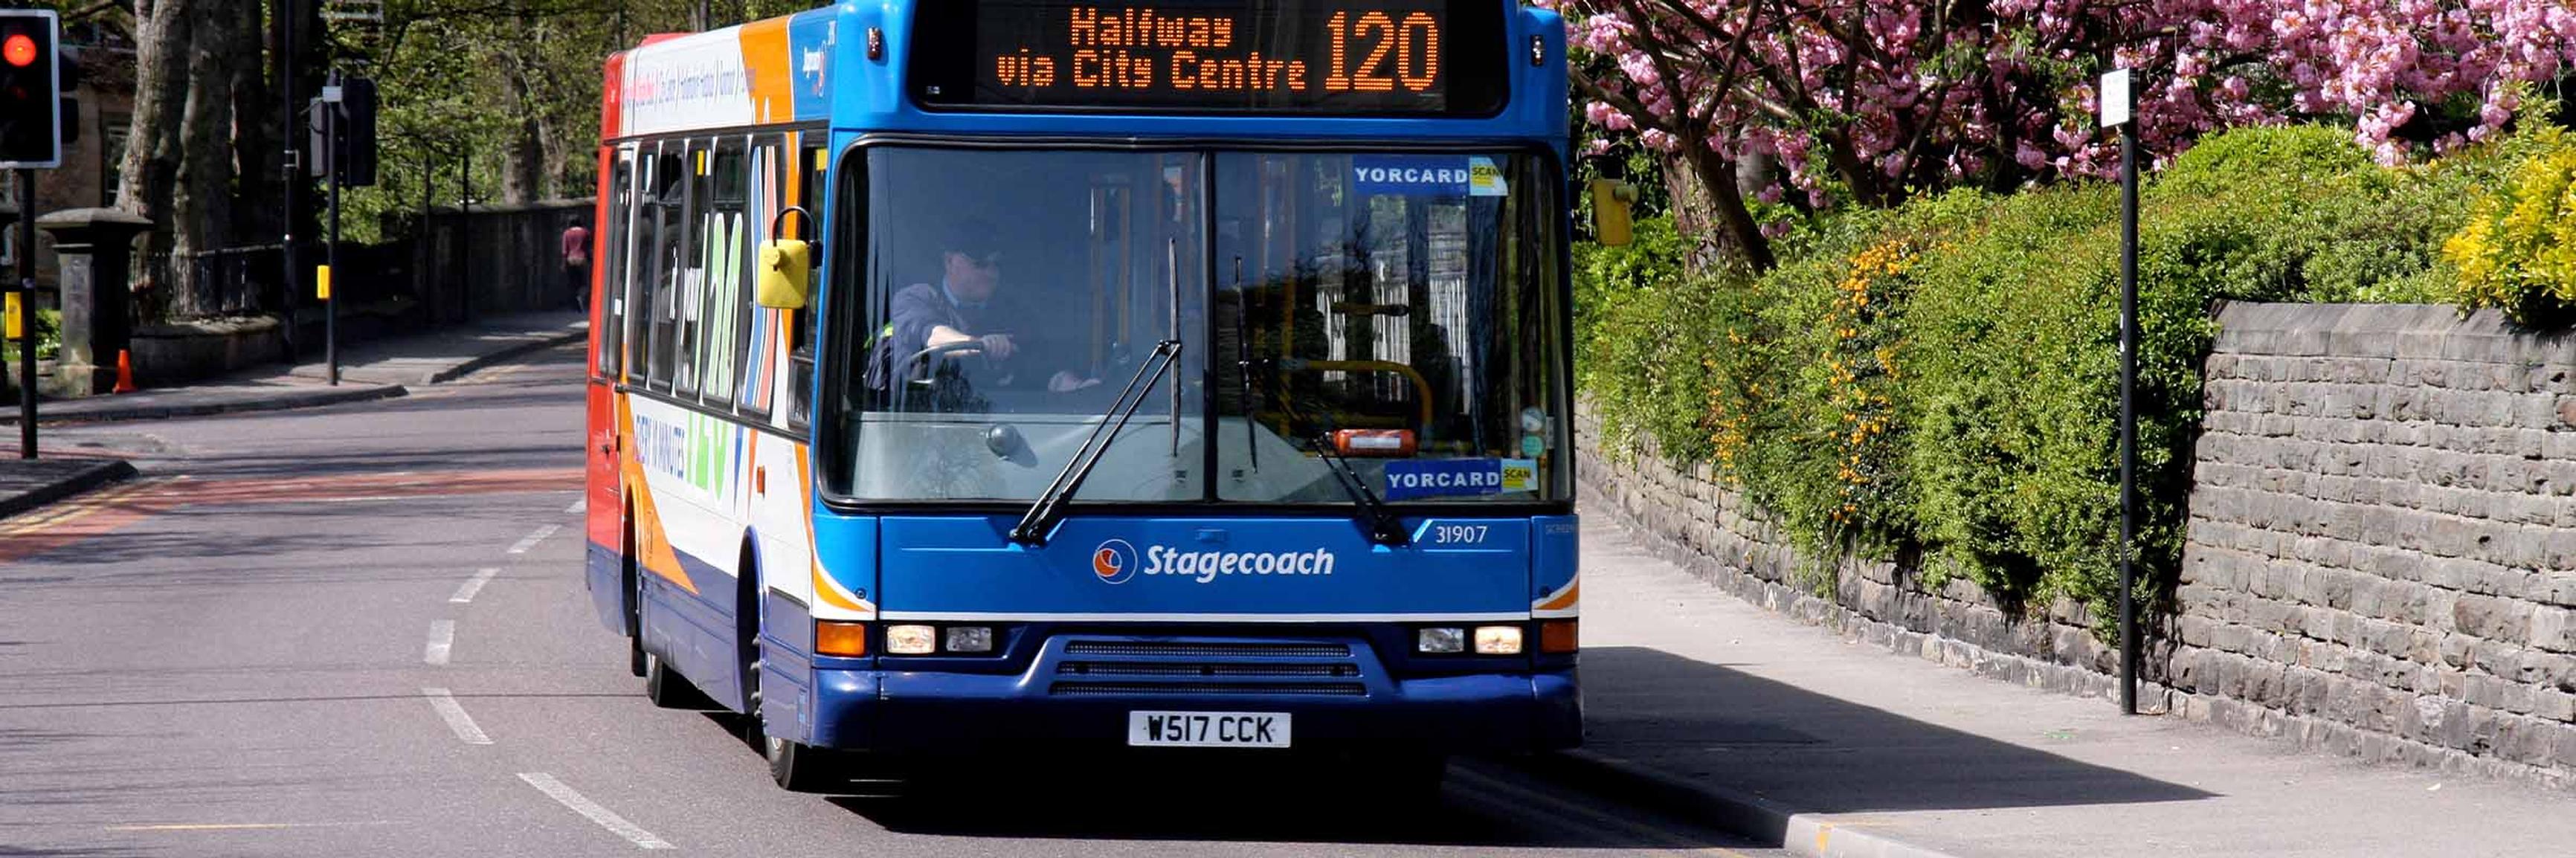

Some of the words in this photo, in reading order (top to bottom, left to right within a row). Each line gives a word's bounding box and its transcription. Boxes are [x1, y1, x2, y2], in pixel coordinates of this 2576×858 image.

[1070, 8, 1231, 47] Halfway
[1325, 10, 1438, 91] 120
[996, 48, 1054, 87] via
[1074, 49, 1152, 88] City
[1171, 51, 1306, 90] Centre
[1356, 168, 1466, 183] YORCARD
[1388, 472, 1499, 488] YORCARD
[1504, 468, 1530, 478] SCAN
[1435, 525, 1487, 543] 31907
[1144, 544, 1335, 584] Stagecoach
[1147, 715, 1210, 742] W517
[1218, 716, 1273, 743] CCK
